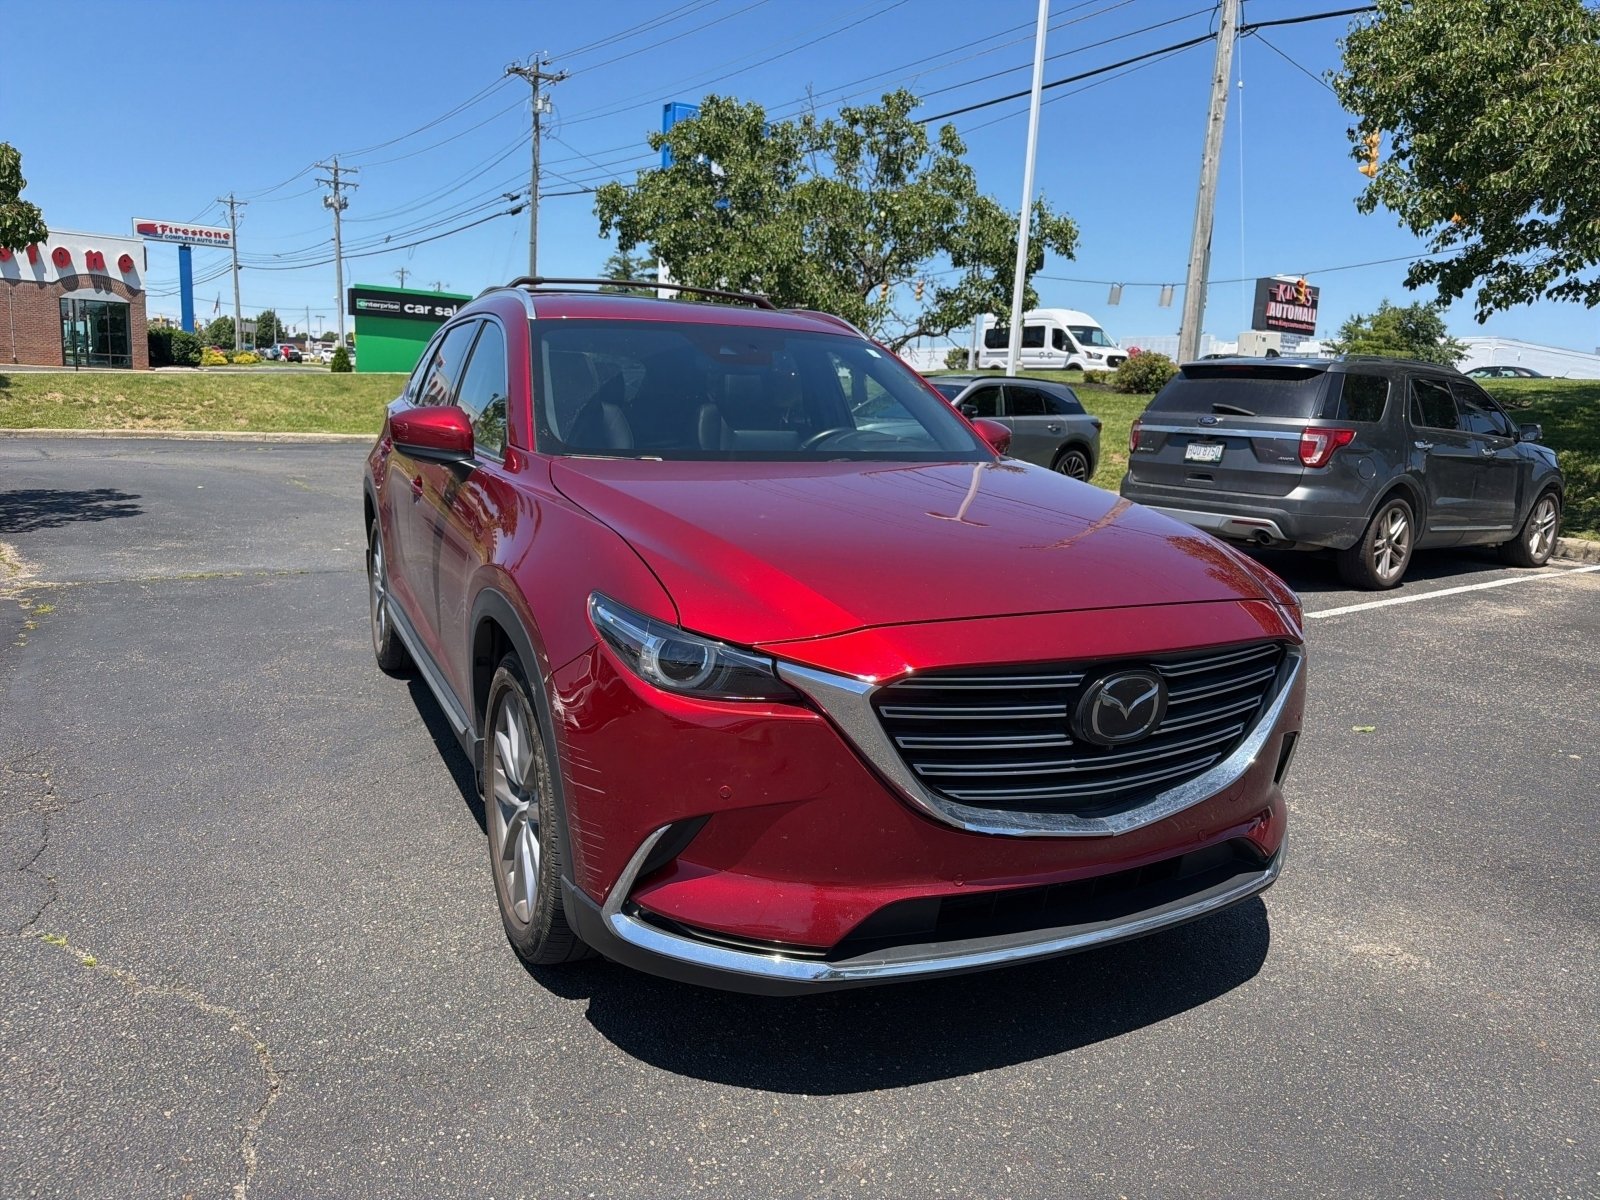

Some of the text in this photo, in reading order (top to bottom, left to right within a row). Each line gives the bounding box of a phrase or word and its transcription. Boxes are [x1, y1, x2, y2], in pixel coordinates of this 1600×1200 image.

[158, 224, 230, 240] Firestone
[164, 233, 195, 242] COMPLETE
[1275, 283, 1313, 307] KINS
[358, 300, 458, 317] enterprise car sal
[1266, 301, 1316, 322] AUTOMALL
